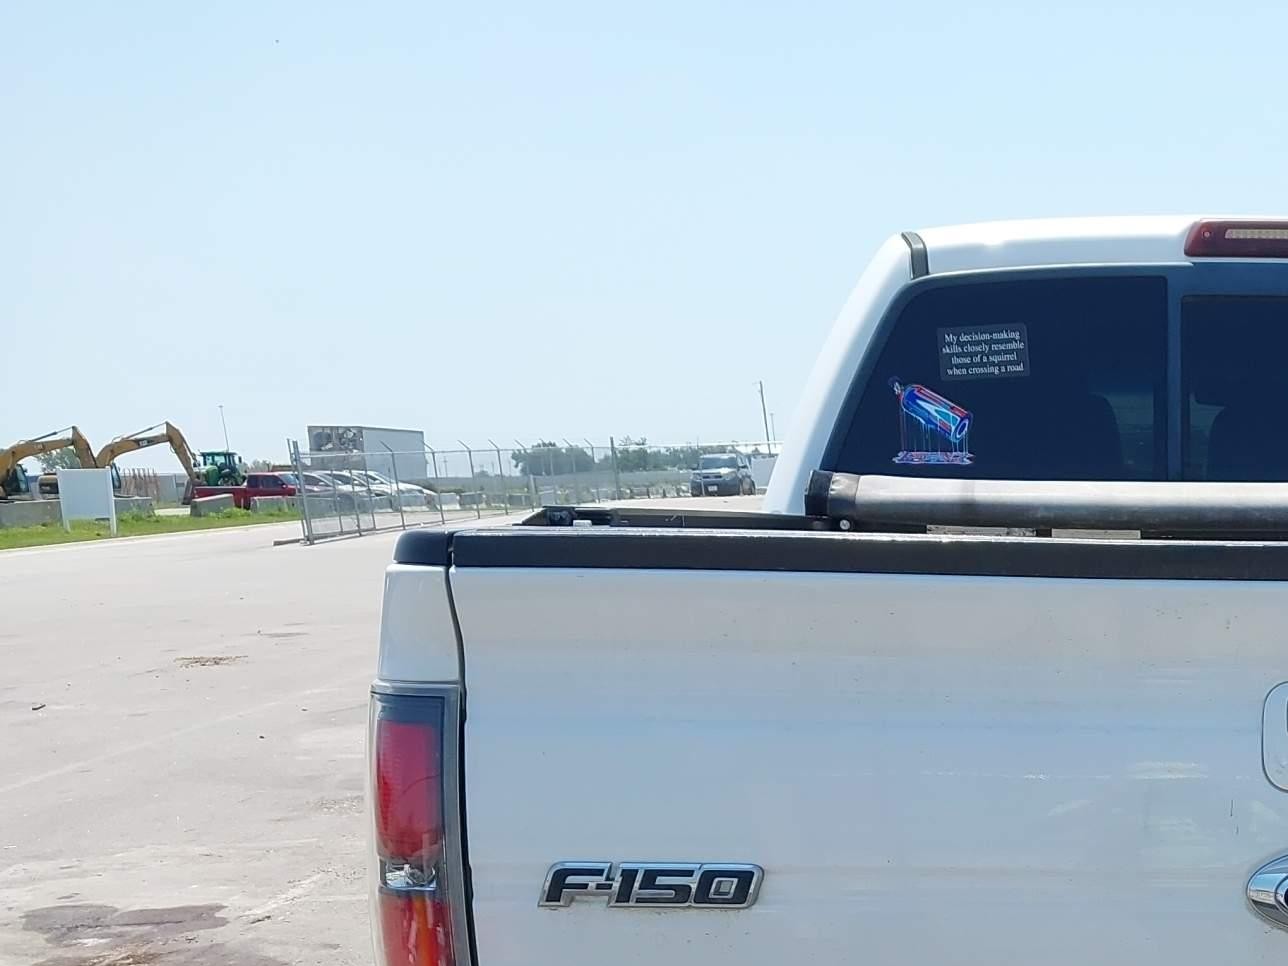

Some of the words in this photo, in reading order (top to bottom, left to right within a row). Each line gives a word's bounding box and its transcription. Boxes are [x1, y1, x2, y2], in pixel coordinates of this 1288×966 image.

[944, 333, 957, 344] My
[959, 330, 1020, 341] decision-making
[942, 345, 962, 353] skills
[963, 342, 989, 353] closely
[991, 341, 1024, 350] resemble
[951, 355, 971, 364] those
[973, 354, 981, 363] of
[988, 352, 1017, 363] squirrel
[946, 366, 967, 375] when
[968, 365, 999, 374] crossing
[1007, 361, 1024, 371] road
[537, 861, 765, 909] F-150
